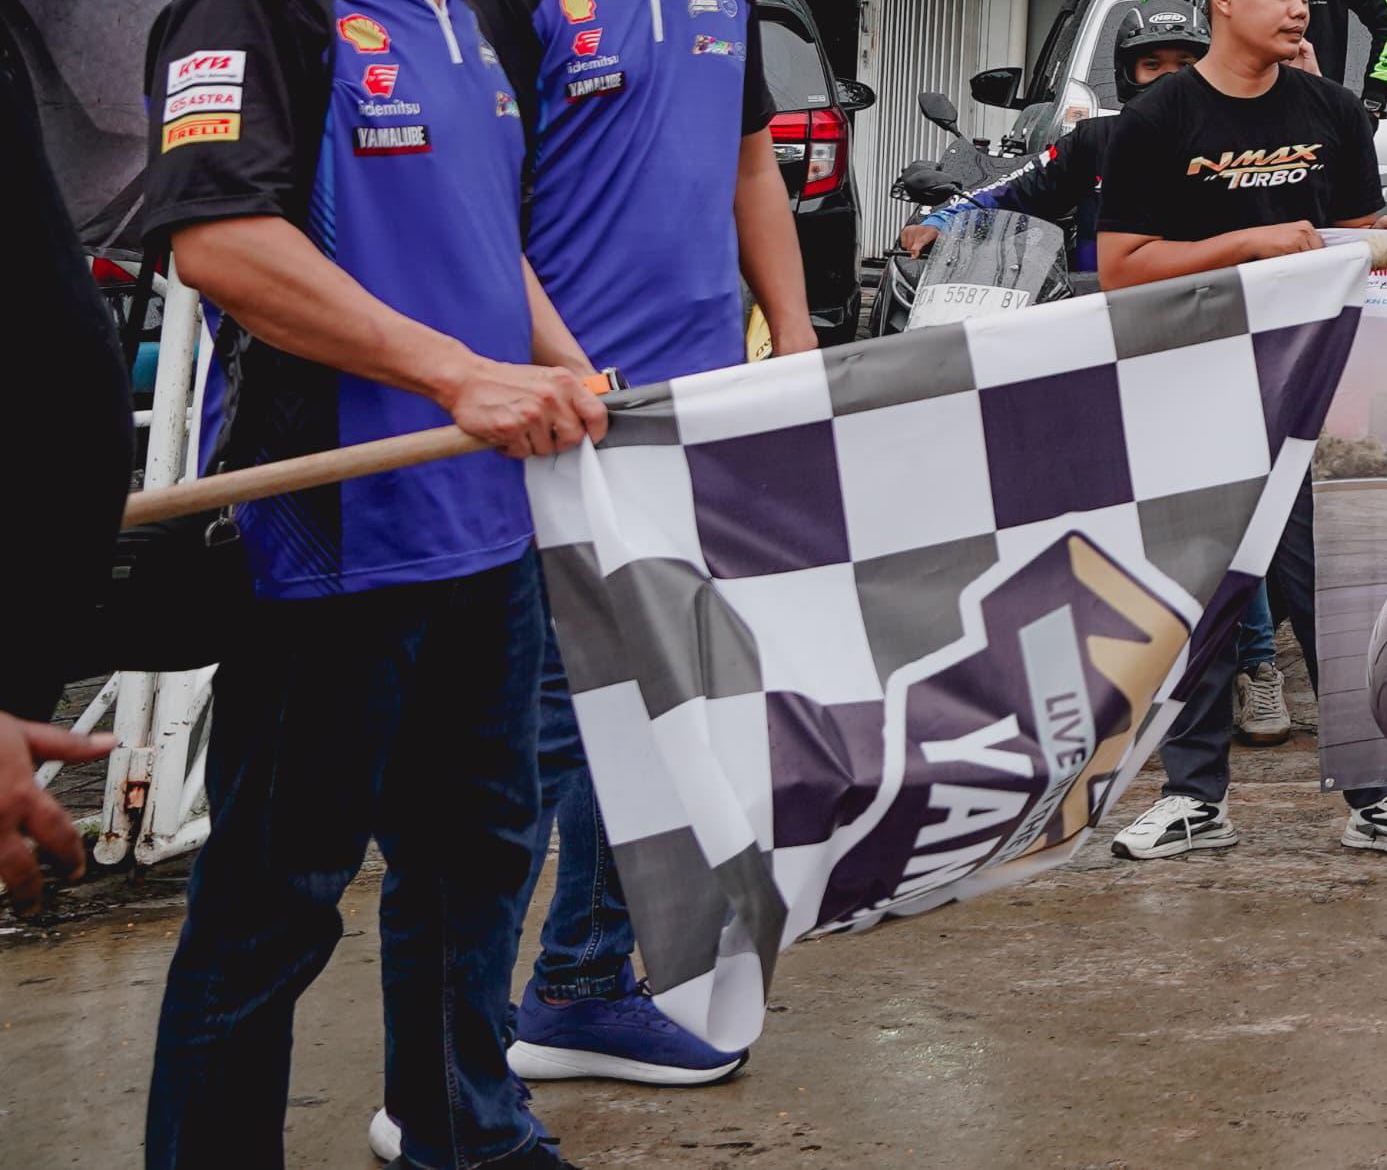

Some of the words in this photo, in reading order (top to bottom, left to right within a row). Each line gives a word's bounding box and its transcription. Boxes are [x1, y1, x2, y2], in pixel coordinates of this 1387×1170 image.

[568, 54, 620, 74] idemitsu
[567, 72, 624, 98] YAMALUBE
[190, 93, 235, 105] ASTRA
[358, 99, 421, 117] idemitsu
[168, 119, 230, 144] PIRELLI
[357, 125, 427, 149] YAMALUBE
[1186, 144, 1324, 176] NMAX
[944, 286, 990, 305] 5587
[1001, 290, 1027, 309] BV
[1045, 691, 1087, 770] LIVE
